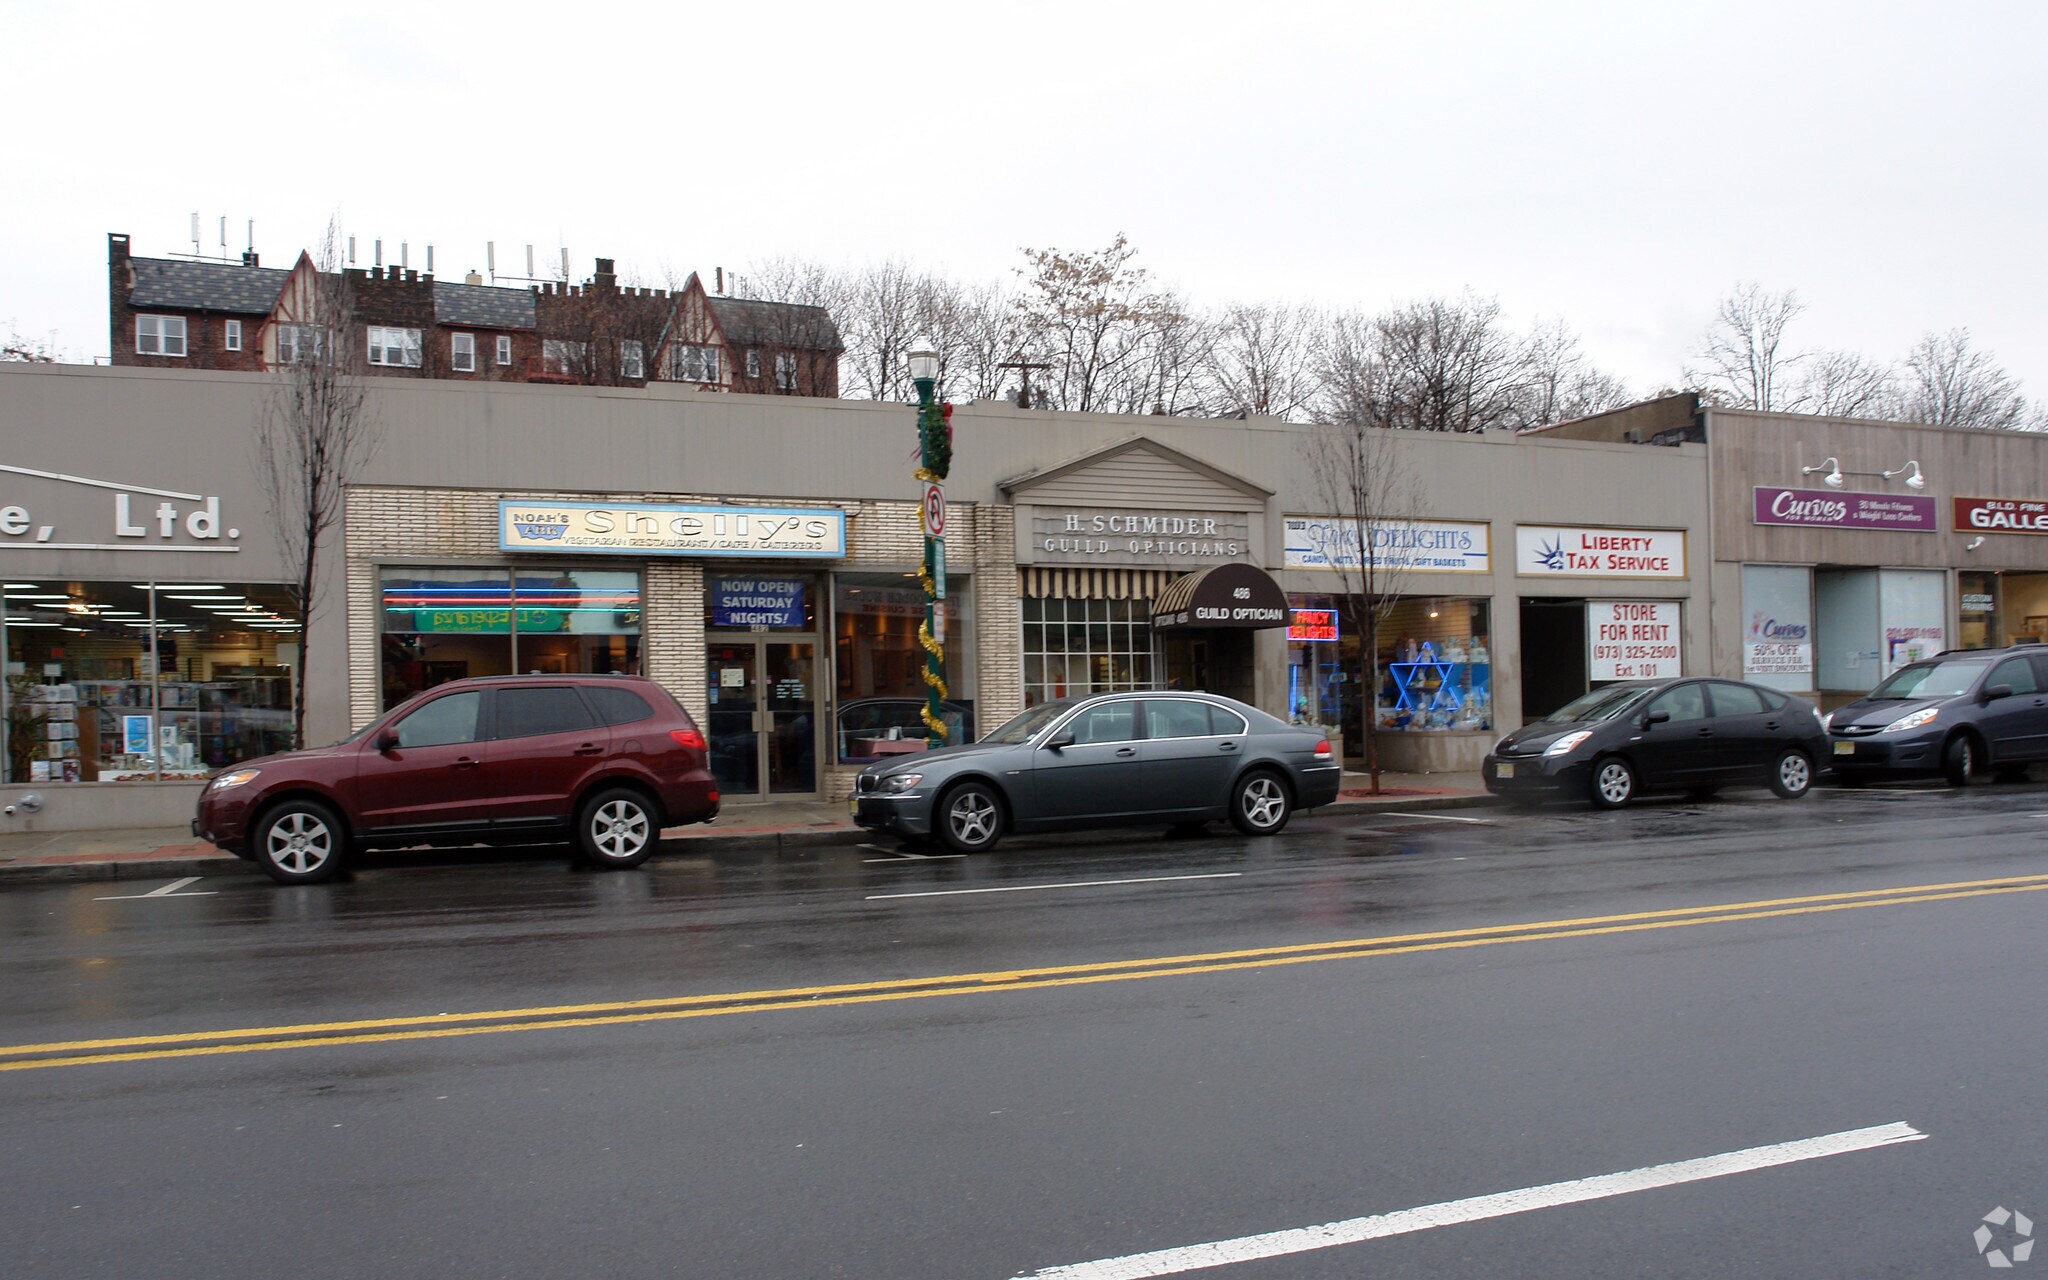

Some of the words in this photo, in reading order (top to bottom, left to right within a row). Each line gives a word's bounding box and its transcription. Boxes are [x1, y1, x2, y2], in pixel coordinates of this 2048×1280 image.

[1771, 490, 1848, 521] Curves
[2019, 503, 2046, 512] FINE
[115, 493, 241, 539] Ltd.
[513, 512, 569, 523] NOAH'S
[1969, 507, 2048, 530] GALLE
[524, 524, 558, 536] ARK
[584, 510, 828, 541] Shelly's
[1065, 514, 1086, 532] H.
[1092, 515, 1218, 536] SCHMIDER
[563, 536, 627, 546] VEGETARIAN
[629, 537, 708, 548] RESTAURANT
[719, 540, 750, 549] CAFE
[759, 541, 823, 550] CATERERS
[1373, 527, 1472, 550] DELIGHTS
[1581, 533, 1653, 551] LIBERTY
[1044, 538, 1110, 554] GUILD
[1129, 540, 1239, 556] OPTICIANS
[1434, 558, 1467, 568] BASKETS
[1566, 552, 1600, 570] TAX
[1607, 554, 1670, 571] SERVICE
[721, 581, 755, 593] NOW
[758, 581, 795, 593] OPEN
[1233, 587, 1251, 599] 486
[722, 596, 794, 609] SATURDAY
[1961, 602, 1995, 612] FRAMING
[730, 612, 790, 624] NIGHTS!
[1195, 607, 1230, 619] GUILD
[1233, 608, 1283, 620] OPTICIAN
[1296, 611, 1330, 625] FANCY
[1613, 604, 1657, 621] STORE
[1289, 625, 1337, 639] DELIGHTS
[1600, 624, 1628, 641] FOR
[1632, 624, 1670, 641] RENT
[1763, 618, 1807, 639] Curves
[1593, 645, 1623, 661] (973)
[1625, 645, 1678, 659] 325-2500
[1754, 644, 1776, 656] 50%
[1778, 644, 1799, 656] OFF
[1751, 656, 1786, 665] SERVICE
[1615, 663, 1635, 677] Ext.
[1639, 663, 1658, 677] 101
